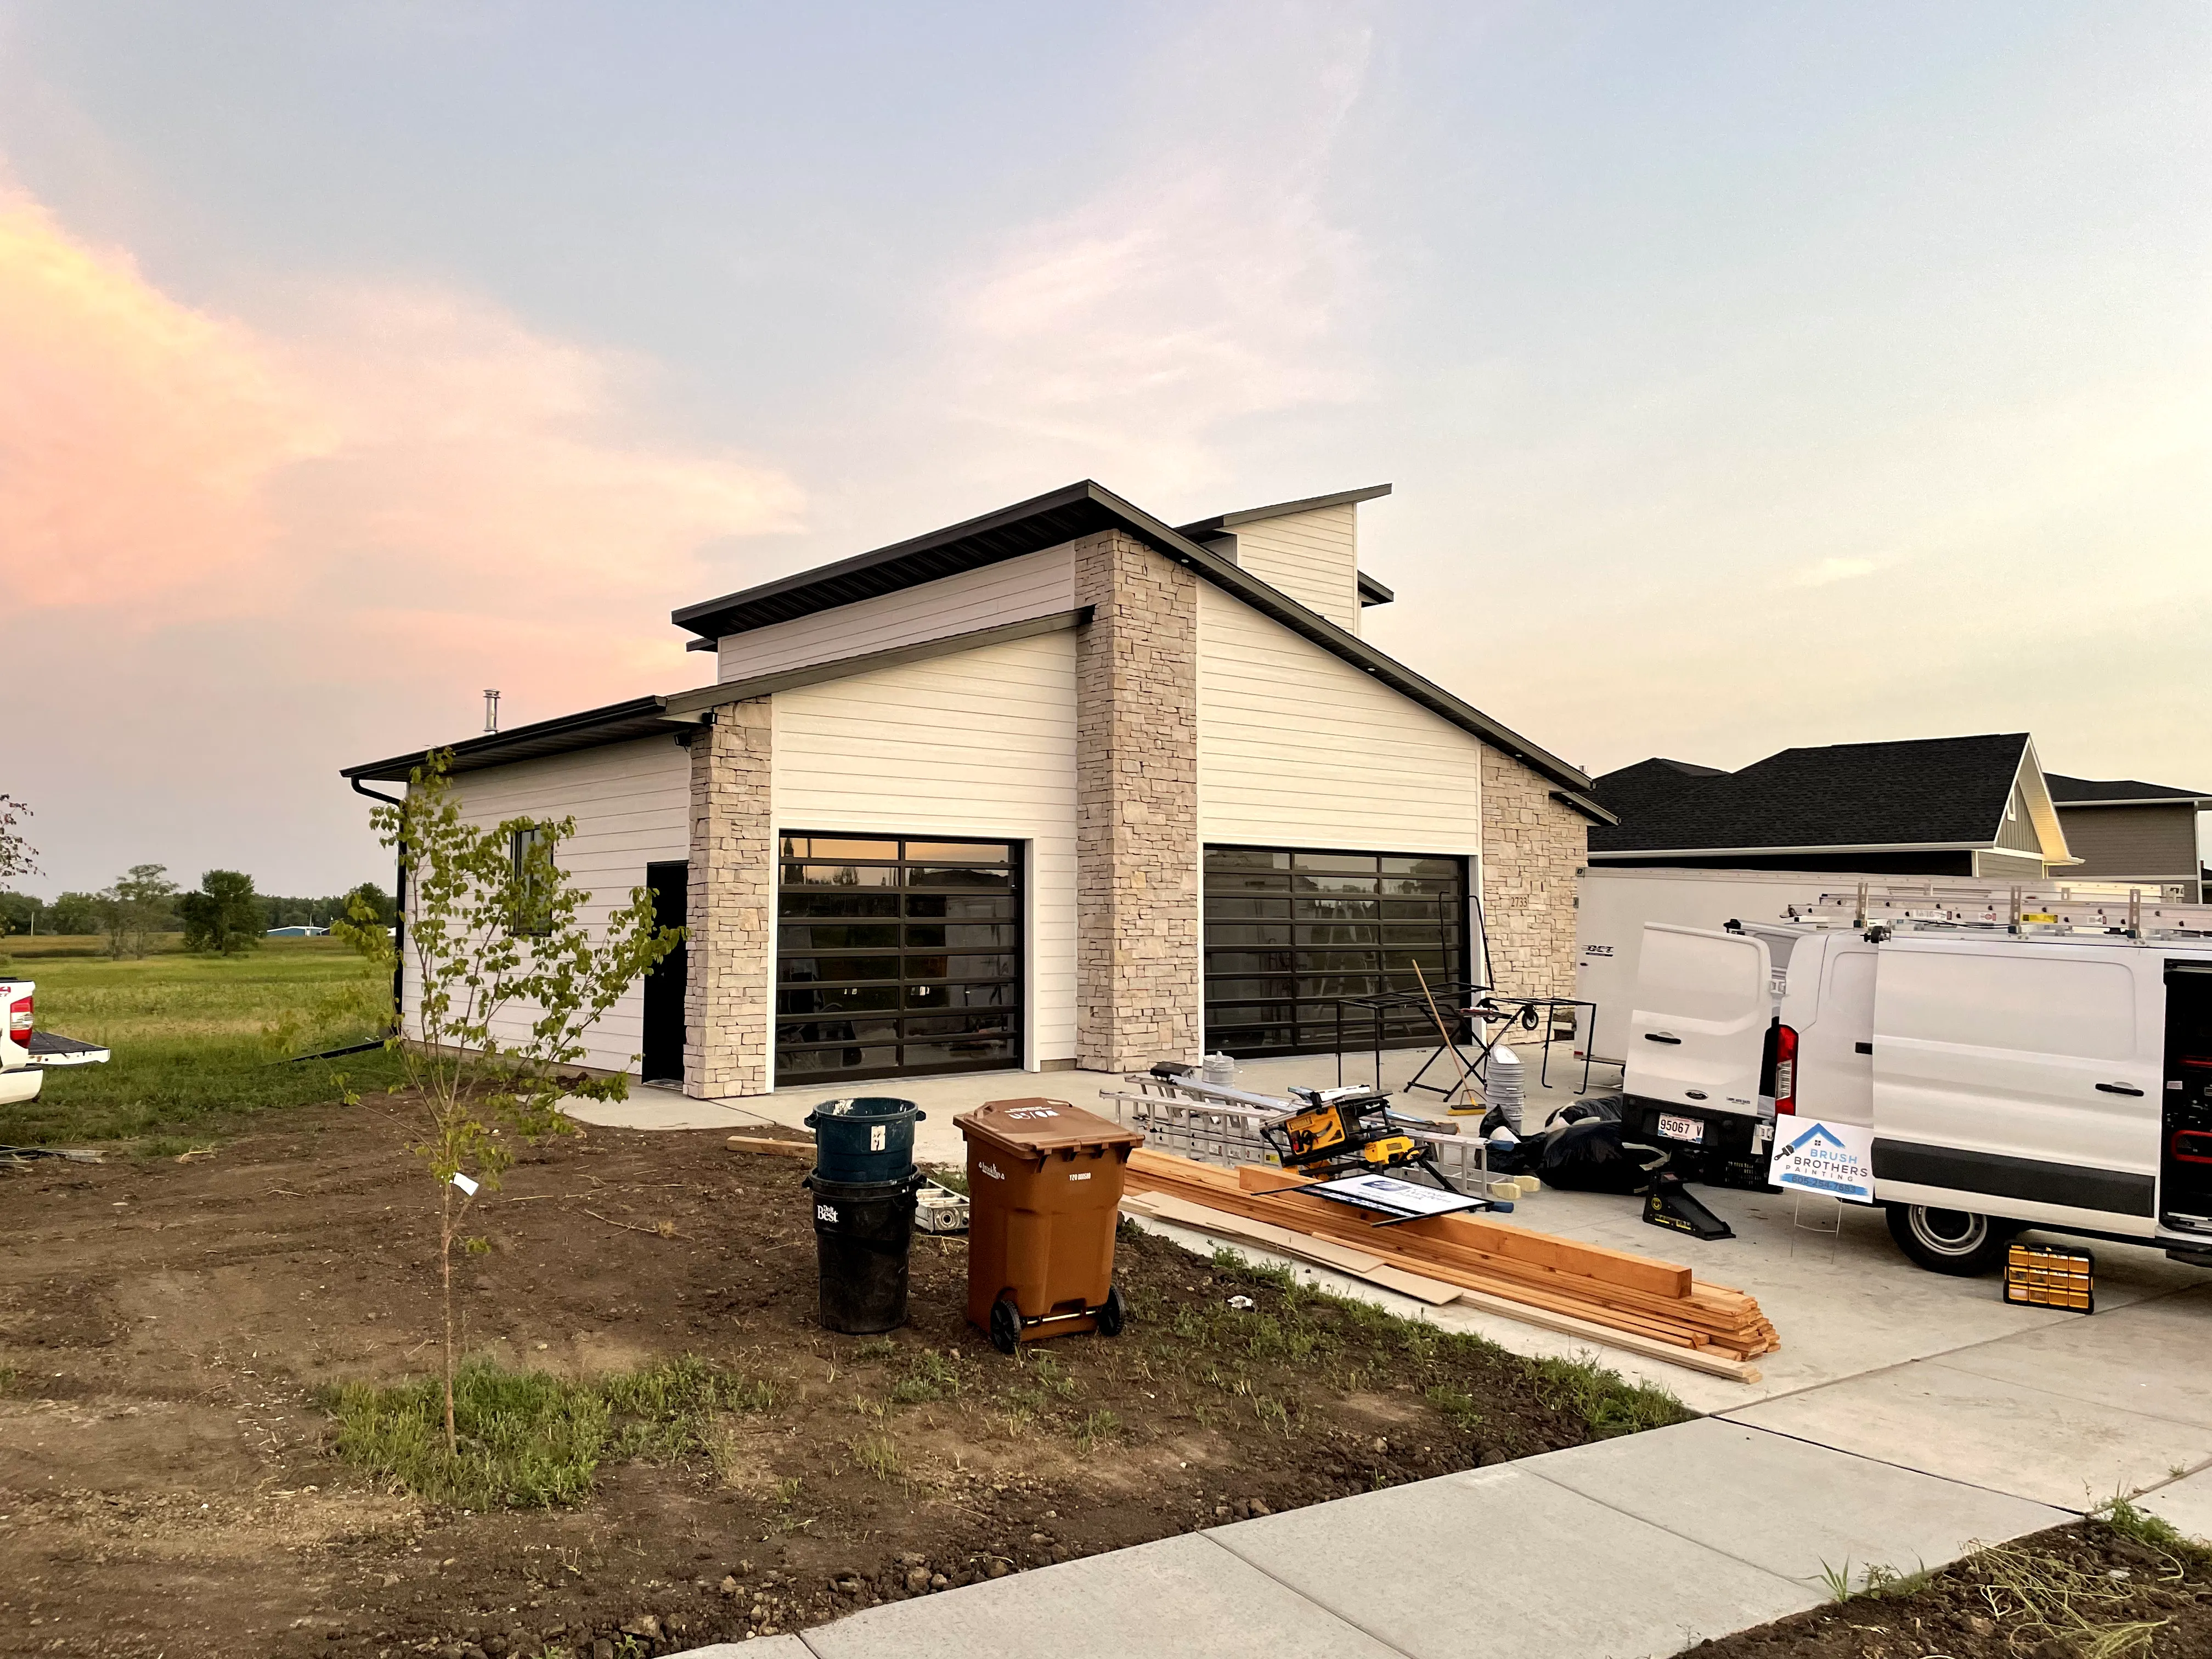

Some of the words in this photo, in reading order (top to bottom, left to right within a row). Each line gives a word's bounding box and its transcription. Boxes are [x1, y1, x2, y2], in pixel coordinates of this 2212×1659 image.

[1510, 896, 1528, 907] 2733
[1660, 1119, 1690, 1133] 95067
[1696, 1125, 1701, 1136] V
[1810, 1149, 1858, 1164] BRUSH
[1785, 1165, 1853, 1182] PAINTING
[1794, 1156, 1868, 1177] BROTHERS
[817, 1205, 839, 1223] Best
